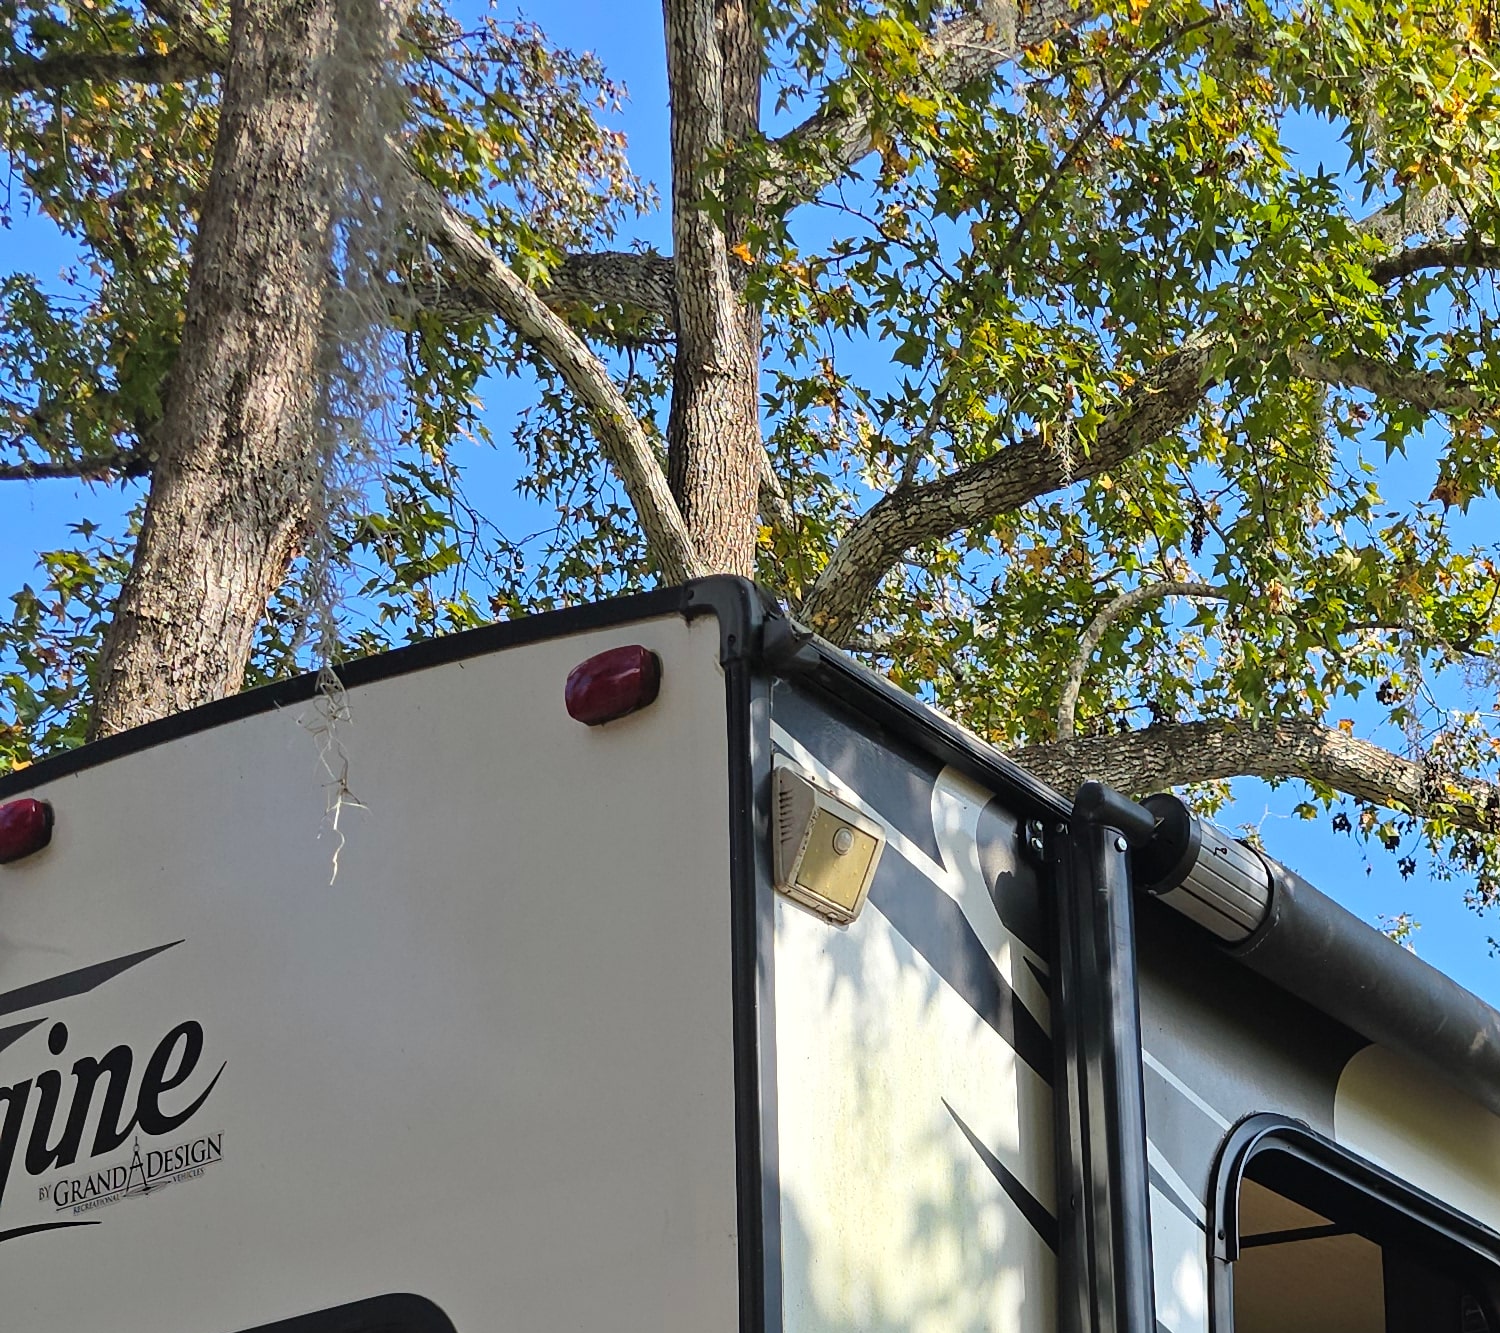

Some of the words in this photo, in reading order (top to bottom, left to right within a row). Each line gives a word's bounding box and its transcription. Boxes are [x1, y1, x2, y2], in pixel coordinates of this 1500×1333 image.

[39, 1185, 51, 1201] BY
[53, 1166, 127, 1207] GRAND
[146, 1133, 223, 1179] DESIGN
[72, 1193, 121, 1215] RECREATIONAL
[172, 1166, 205, 1184] VEHICLES
